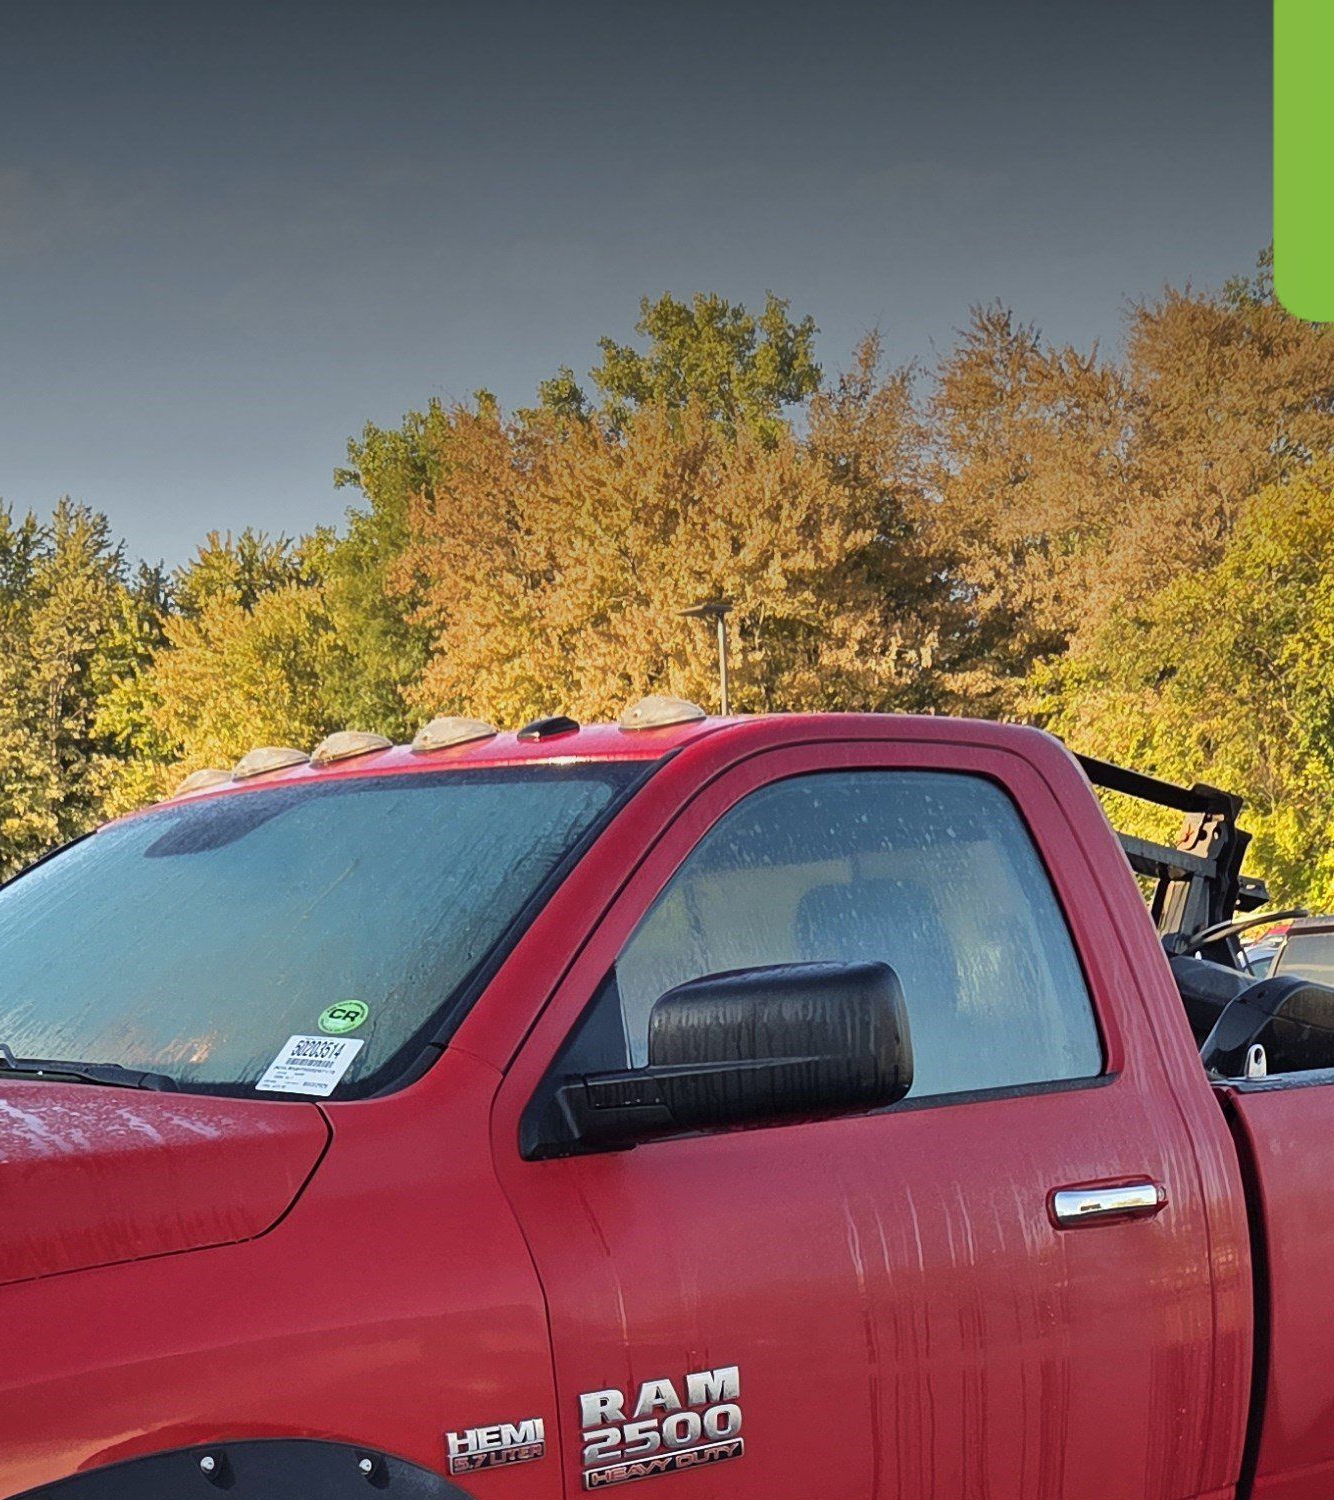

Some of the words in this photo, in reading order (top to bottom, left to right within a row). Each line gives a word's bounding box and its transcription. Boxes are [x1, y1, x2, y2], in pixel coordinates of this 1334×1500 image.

[328, 1008, 360, 1022] CR
[578, 1365, 741, 1429] RAM
[446, 1418, 545, 1456] HEMI
[582, 1402, 743, 1467] 2500
[454, 1453, 488, 1472] 5.7
[489, 1443, 543, 1466] LITER
[591, 1456, 673, 1486] HEAVY
[675, 1442, 740, 1469] DUTY
